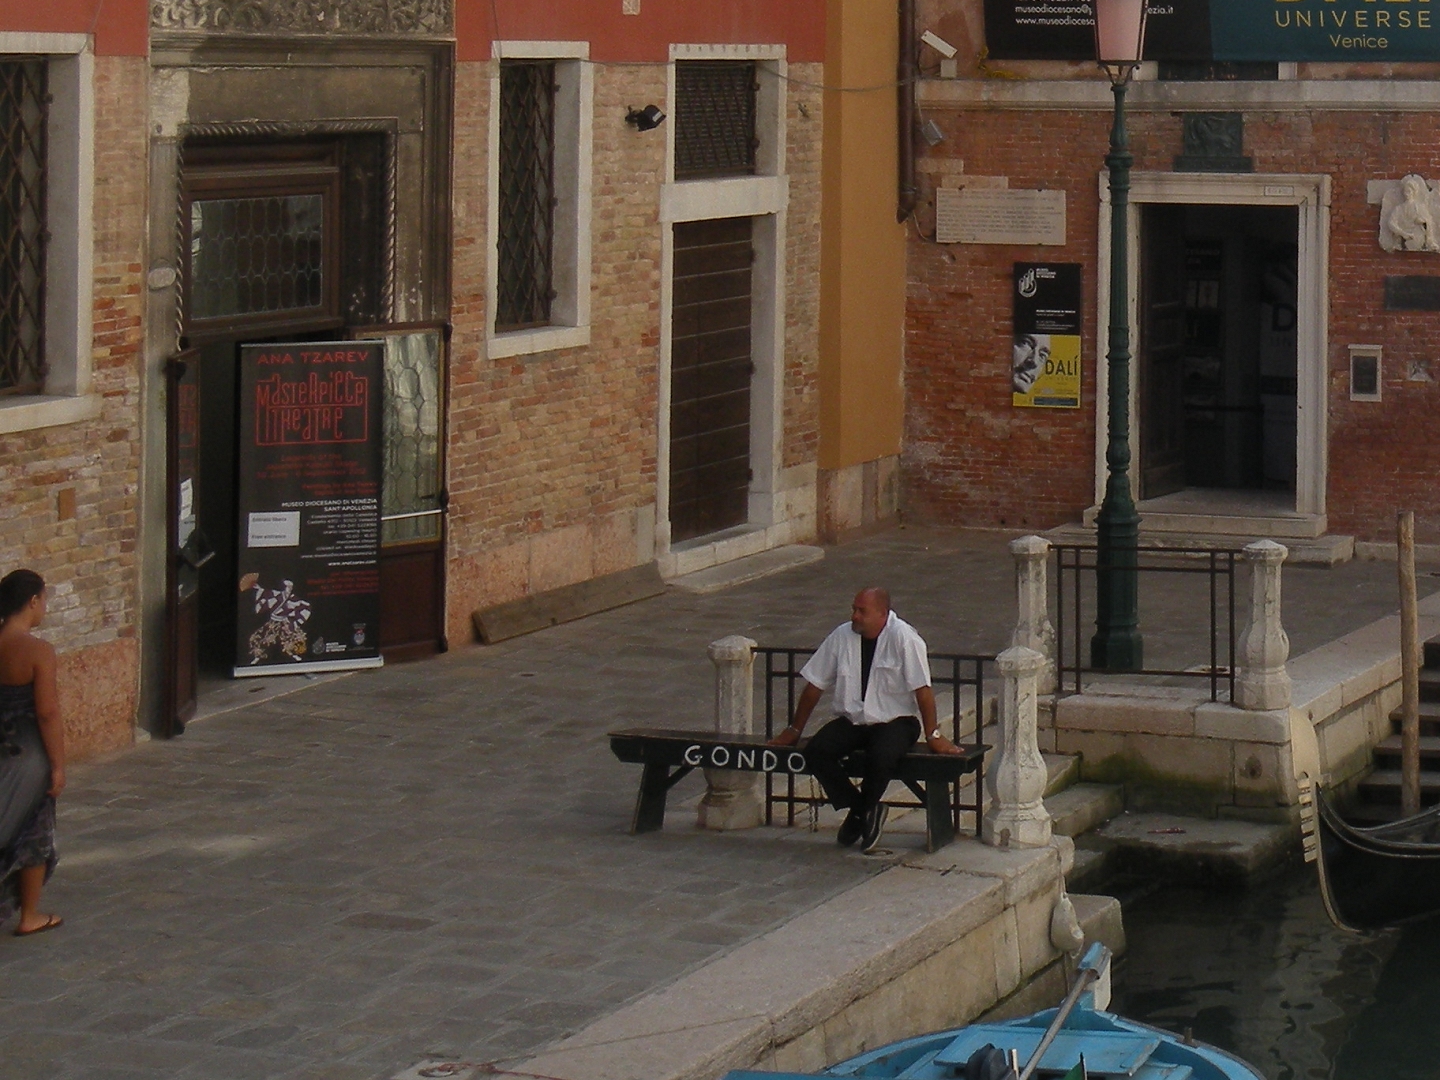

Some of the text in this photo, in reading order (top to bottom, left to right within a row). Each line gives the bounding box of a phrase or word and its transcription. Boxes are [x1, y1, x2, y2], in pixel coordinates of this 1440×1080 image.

[1275, 10, 1431, 28] UNIVERSE
[1329, 34, 1389, 49] Venice
[257, 351, 369, 365] ANA TZAREV
[1045, 355, 1078, 376] DALÍ
[684, 745, 806, 772] GONDO
